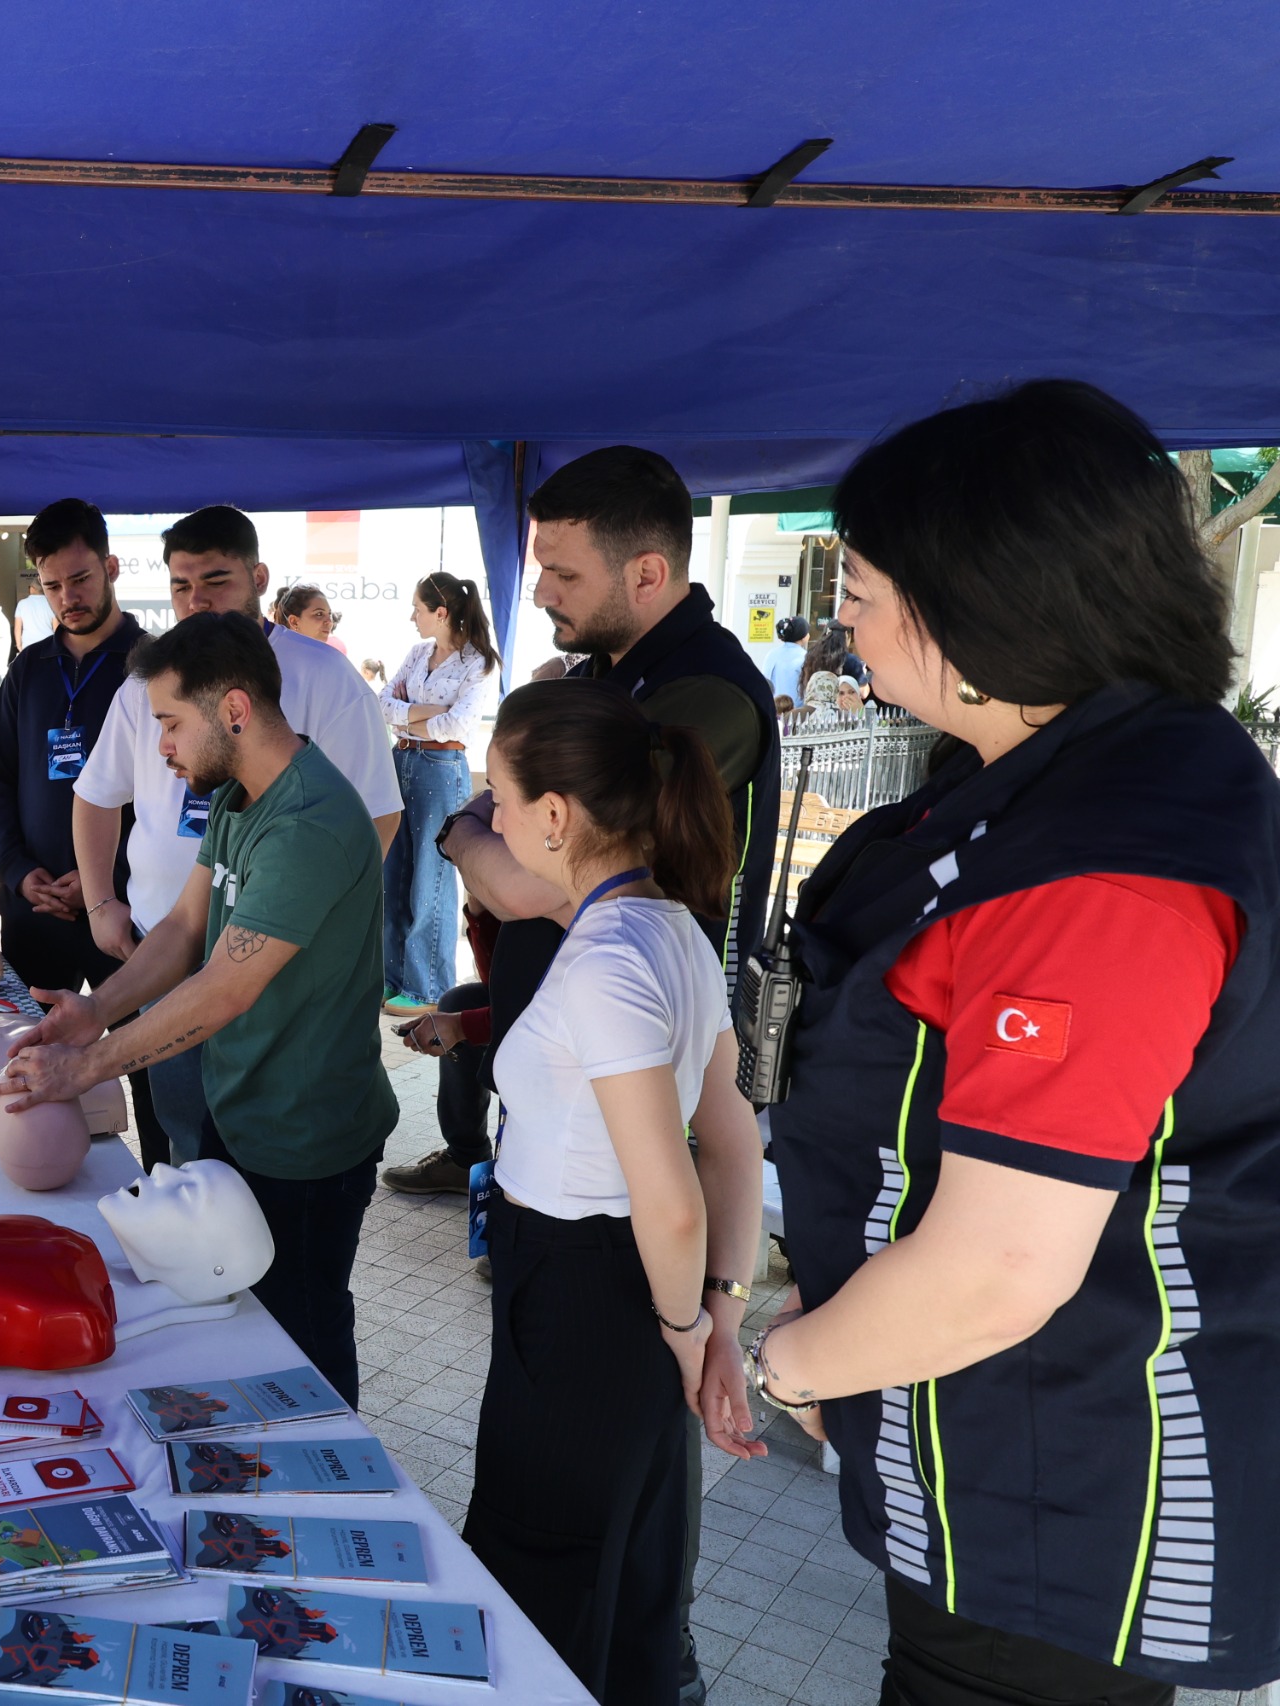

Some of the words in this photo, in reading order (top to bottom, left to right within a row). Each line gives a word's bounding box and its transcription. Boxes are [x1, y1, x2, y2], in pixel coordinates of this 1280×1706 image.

[284, 576, 399, 600] Ksaba
[262, 1381, 301, 1409] DEPREM
[320, 1448, 351, 1481] DEPREM
[349, 1529, 376, 1568] DEPREM
[401, 1612, 430, 1658] DEPREM
[171, 1643, 191, 1692] DEPREM
